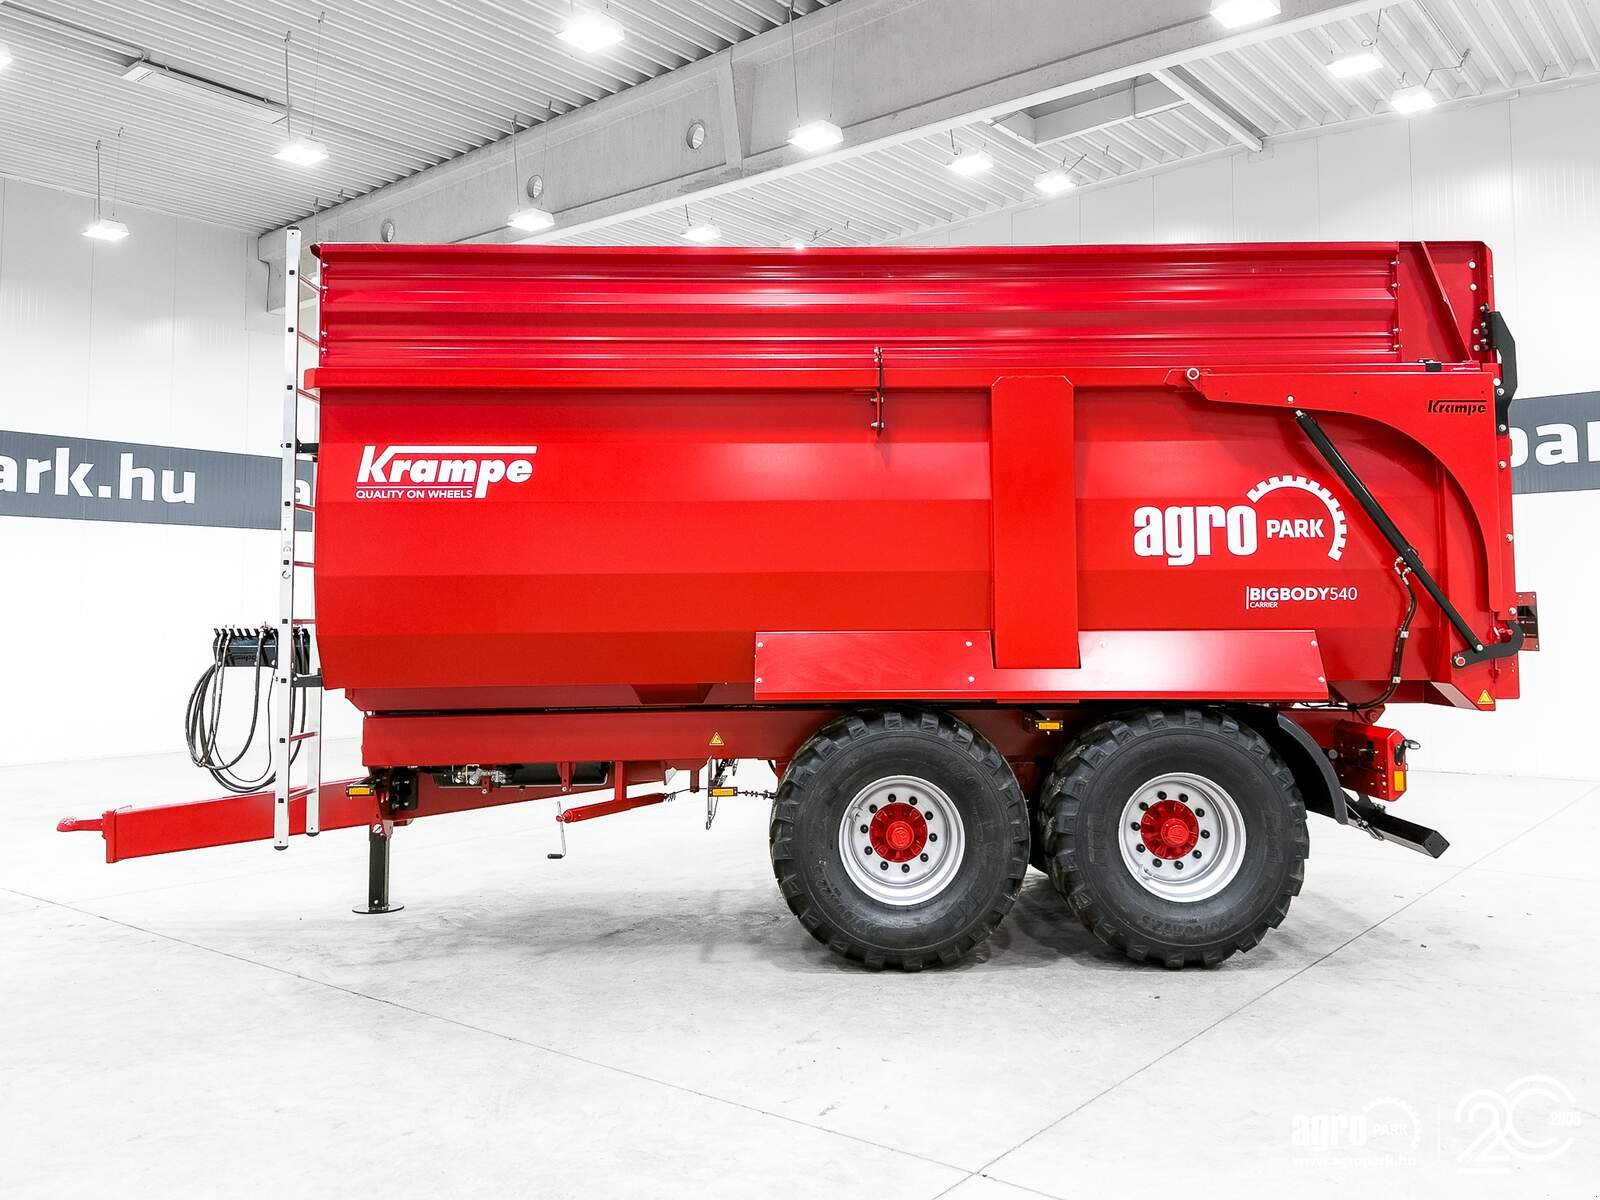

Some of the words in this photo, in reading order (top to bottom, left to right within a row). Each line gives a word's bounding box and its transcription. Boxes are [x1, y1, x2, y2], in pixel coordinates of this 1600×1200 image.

[1428, 399, 1487, 416] Krampe
[356, 445, 537, 499] Krampe
[356, 489, 404, 499] QUALITY
[407, 489, 424, 499] ON
[428, 489, 473, 499] WHEELS
[1133, 505, 1258, 567] agro
[1266, 518, 1325, 539] PARK
